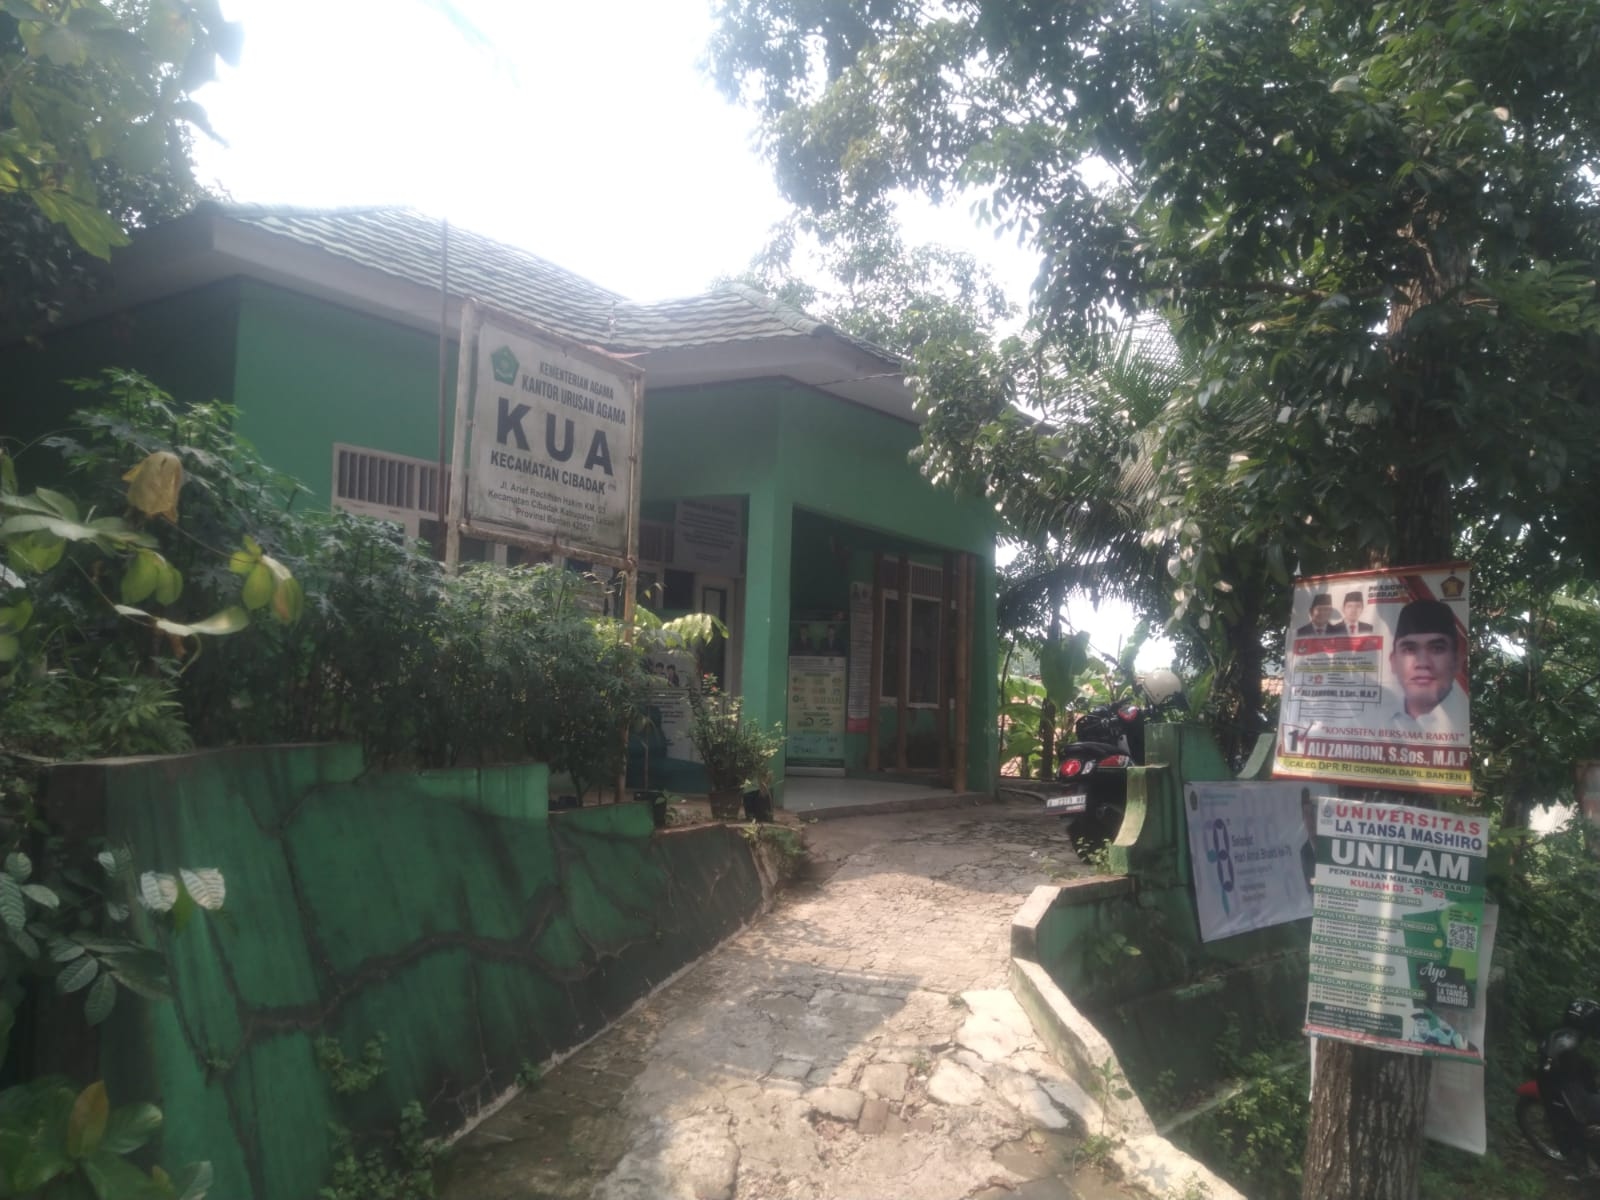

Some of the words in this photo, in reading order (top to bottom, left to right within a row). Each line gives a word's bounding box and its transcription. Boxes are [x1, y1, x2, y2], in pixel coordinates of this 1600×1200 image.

[540, 361, 589, 390] KEMENTERIAN
[590, 379, 614, 400] AGAMA
[522, 374, 559, 401] KANTOR
[561, 388, 594, 414] URUSAN
[595, 399, 626, 425] AGAMA
[491, 449, 559, 482] KECAMATAN
[561, 471, 606, 495] CIBADAK
[488, 488, 529, 506] Kecamatan
[531, 498, 558, 513] Cibadak
[1379, 729, 1423, 740] BERSAMA
[1308, 741, 1326, 757] ALI
[1433, 750, 1468, 767] M.A.P
[1289, 760, 1316, 769] CALEG
[1319, 761, 1340, 771] DPR
[1342, 763, 1352, 772] RI
[1354, 765, 1397, 777] GERINDRA
[1399, 768, 1424, 778] DAPIL
[1426, 770, 1463, 781] BANTEN
[1336, 804, 1480, 835] UNIVERSITAS
[1335, 819, 1353, 833] LA
[1358, 822, 1405, 839] TANSA
[1411, 828, 1482, 850] MASHIRO
[1331, 838, 1470, 882] UNILAM
[1319, 885, 1352, 895] FAKULTAS
[1329, 867, 1388, 881] PENERIMAAN
[1389, 873, 1440, 889] MAHASISWA
[1350, 879, 1389, 892] KULIAH
[1432, 890, 1445, 899] S2
[1419, 962, 1446, 983] Ayo
